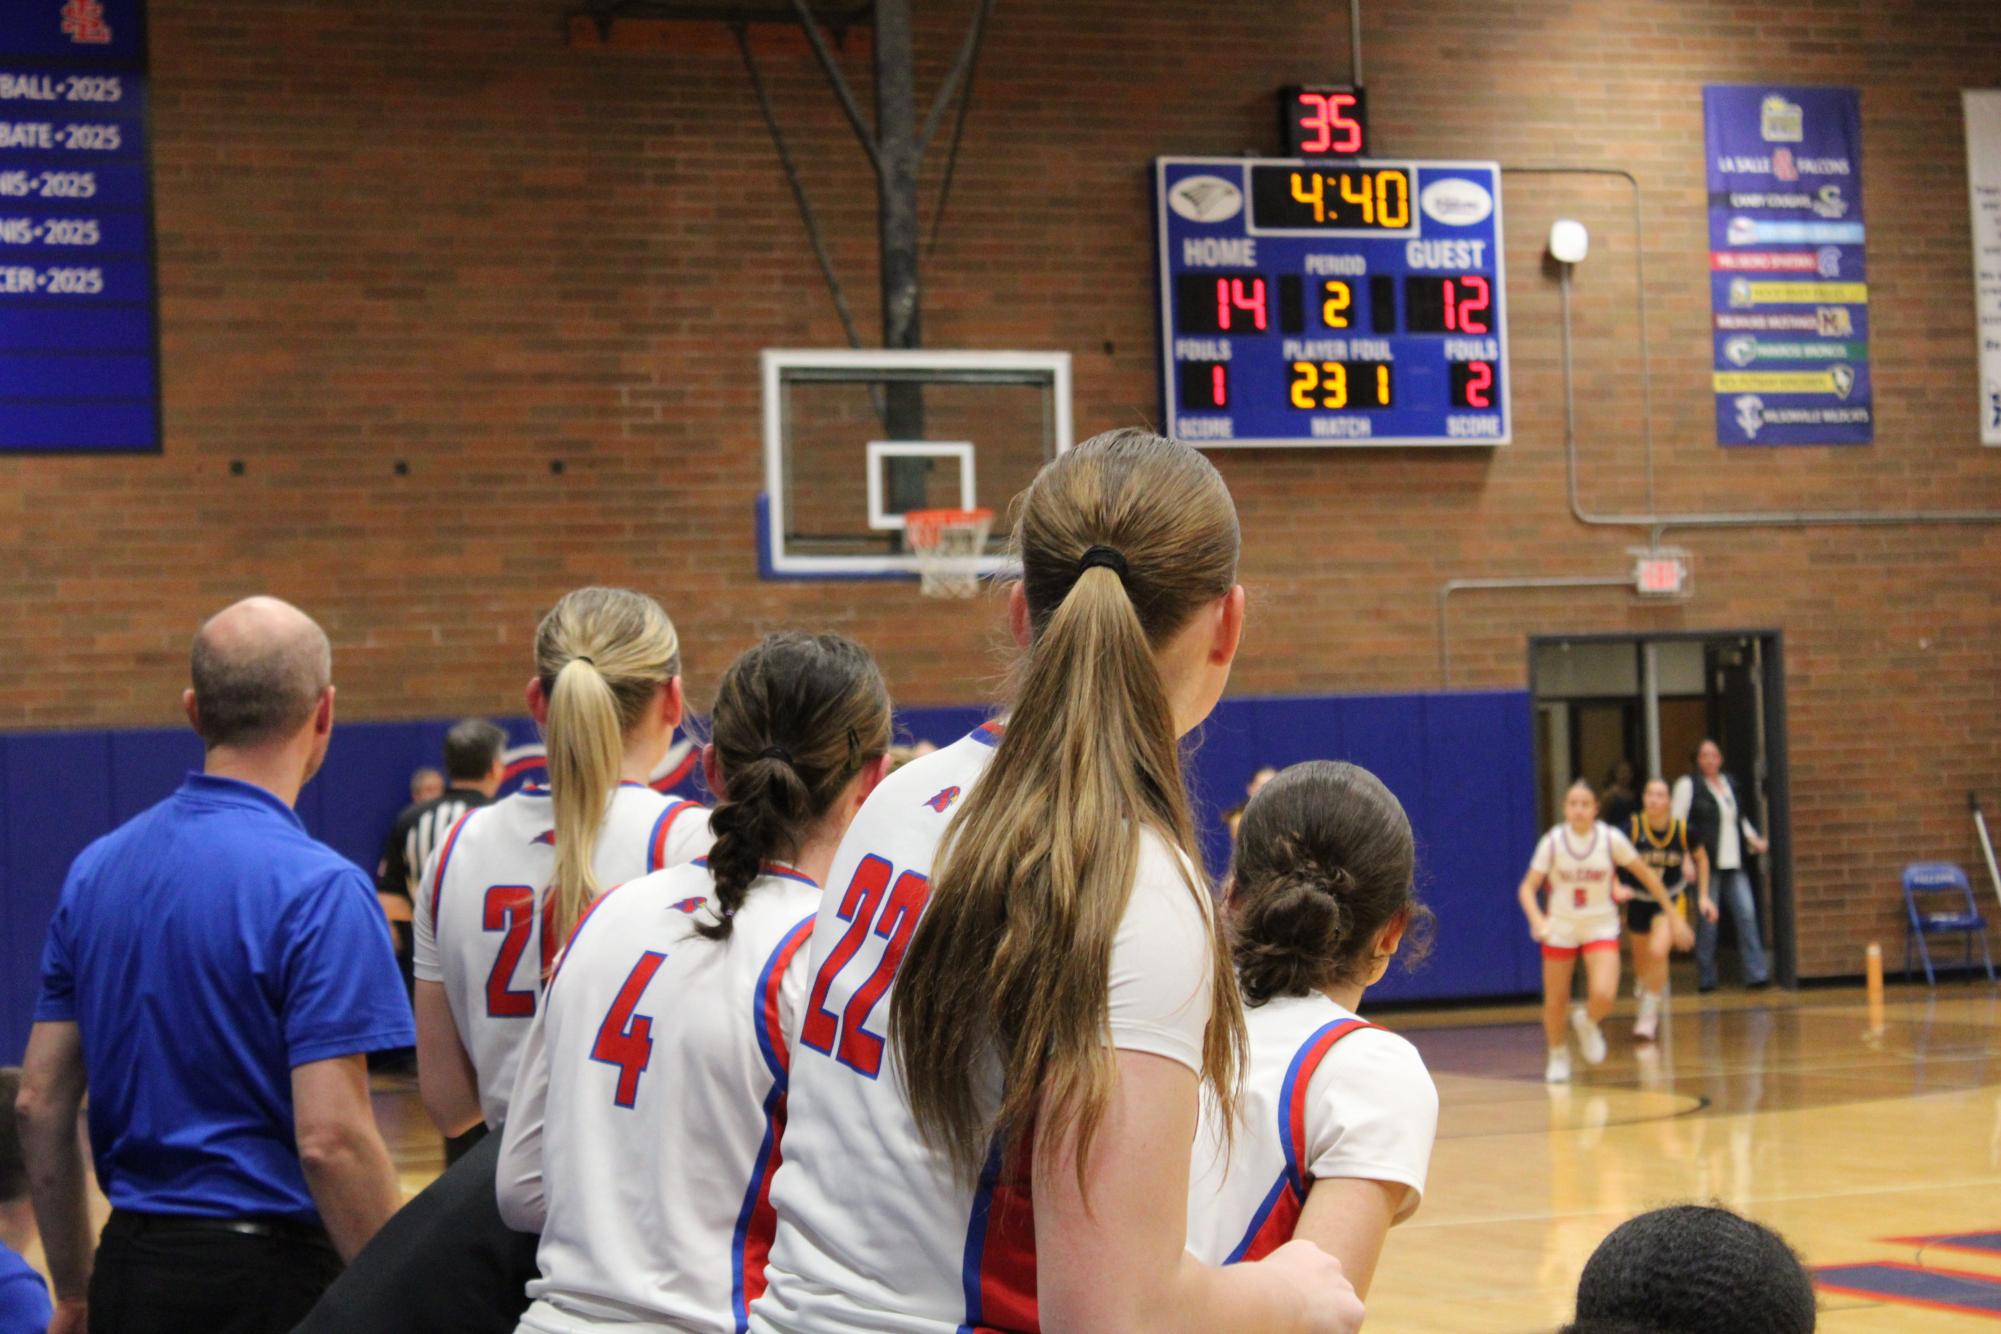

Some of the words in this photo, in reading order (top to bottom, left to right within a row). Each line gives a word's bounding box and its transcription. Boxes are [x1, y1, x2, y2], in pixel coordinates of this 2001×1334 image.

[1299, 94, 1361, 153] 35
[1291, 170, 1408, 228] 4:40
[1183, 238, 1257, 267] HOME
[1305, 254, 1366, 276] PERIOD
[1406, 240, 1486, 269] GUEST
[1217, 277, 1267, 330] 14
[1322, 280, 1350, 328] 2
[1443, 275, 1490, 334] 12
[1176, 339, 1232, 361] FOULS
[1283, 339, 1347, 361] PLAYER
[1350, 339, 1393, 361] FOUL
[1444, 339, 1498, 361] FOULS
[1212, 365, 1226, 406] 1
[1290, 361, 1347, 409] 23
[1376, 364, 1389, 405] 1
[1465, 361, 1492, 408] 2
[1177, 417, 1234, 439] SCORE
[1311, 417, 1372, 438] MATCH
[1446, 415, 1500, 438] SCORE
[482, 885, 558, 1017] 2
[800, 853, 930, 1079] 22
[589, 950, 668, 1109] 4
